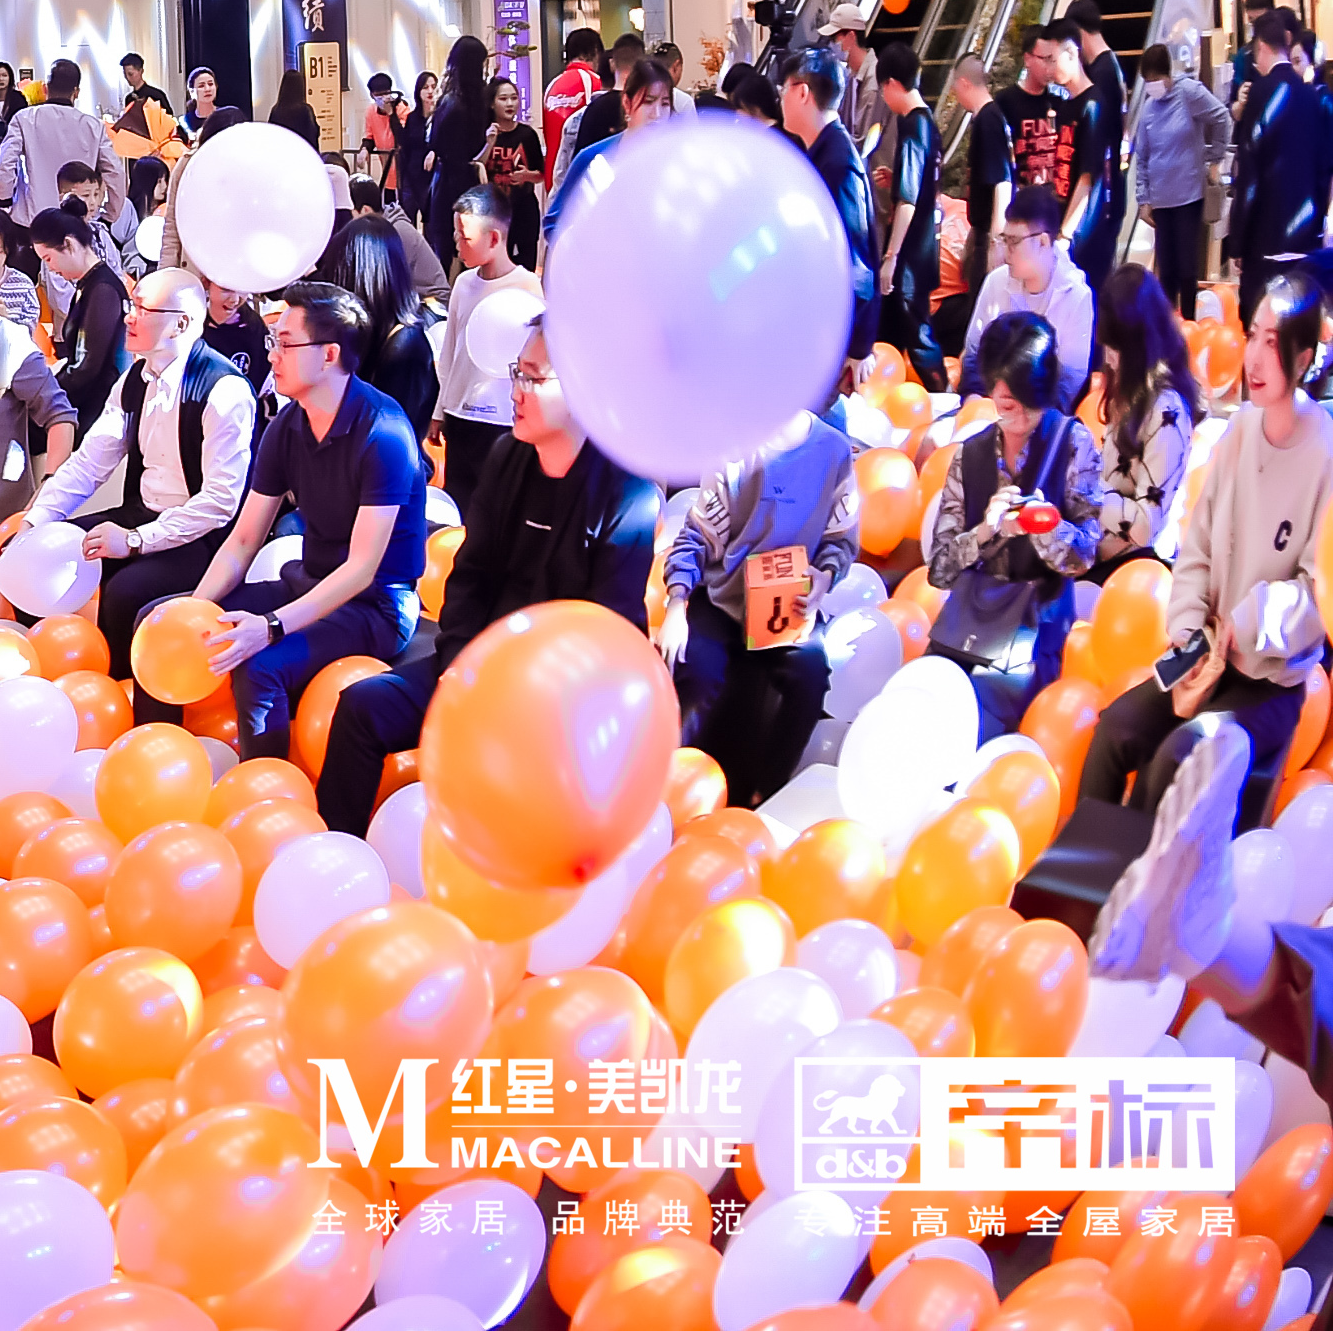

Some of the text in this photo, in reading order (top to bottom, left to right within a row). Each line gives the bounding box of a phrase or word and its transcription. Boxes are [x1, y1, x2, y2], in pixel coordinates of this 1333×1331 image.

[309, 56, 324, 79] B1
[1273, 520, 1294, 551] C
[773, 551, 794, 579] FUN
